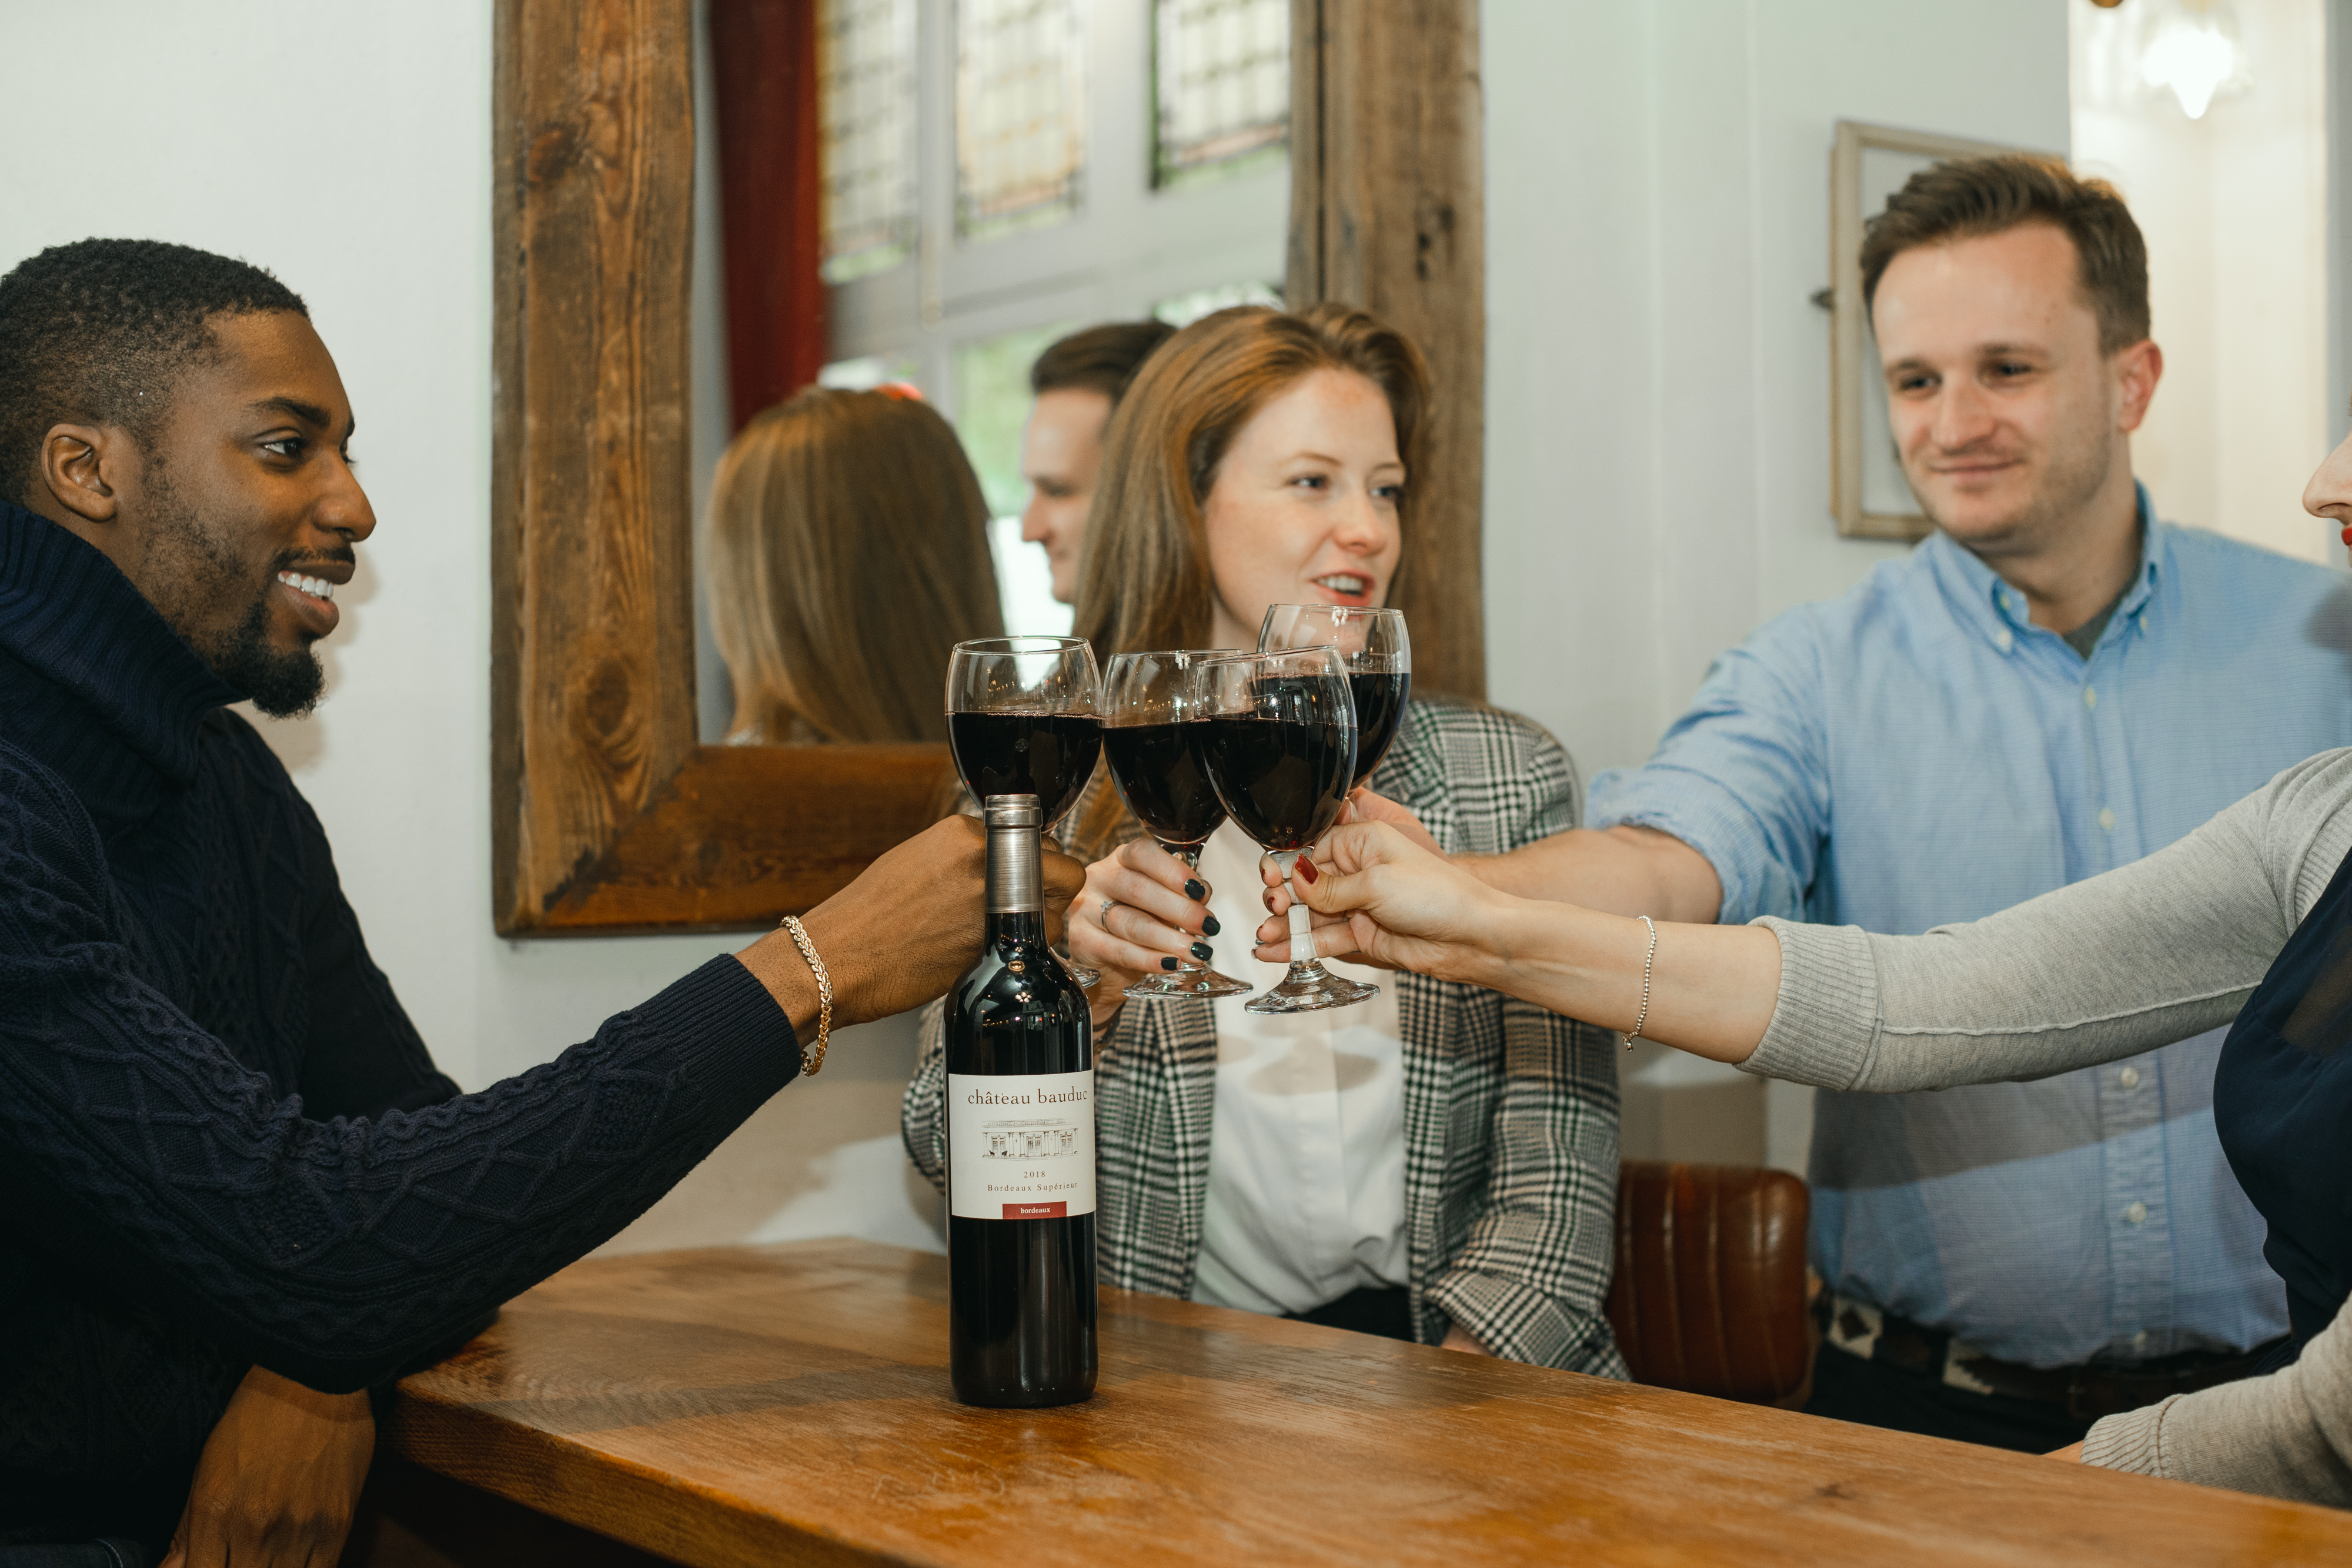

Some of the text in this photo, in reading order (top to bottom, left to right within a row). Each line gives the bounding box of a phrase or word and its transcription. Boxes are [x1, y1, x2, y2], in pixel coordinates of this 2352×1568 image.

[968, 1086, 1087, 1105] château bauduc
[1037, 1182, 1078, 1192] Supérieur
